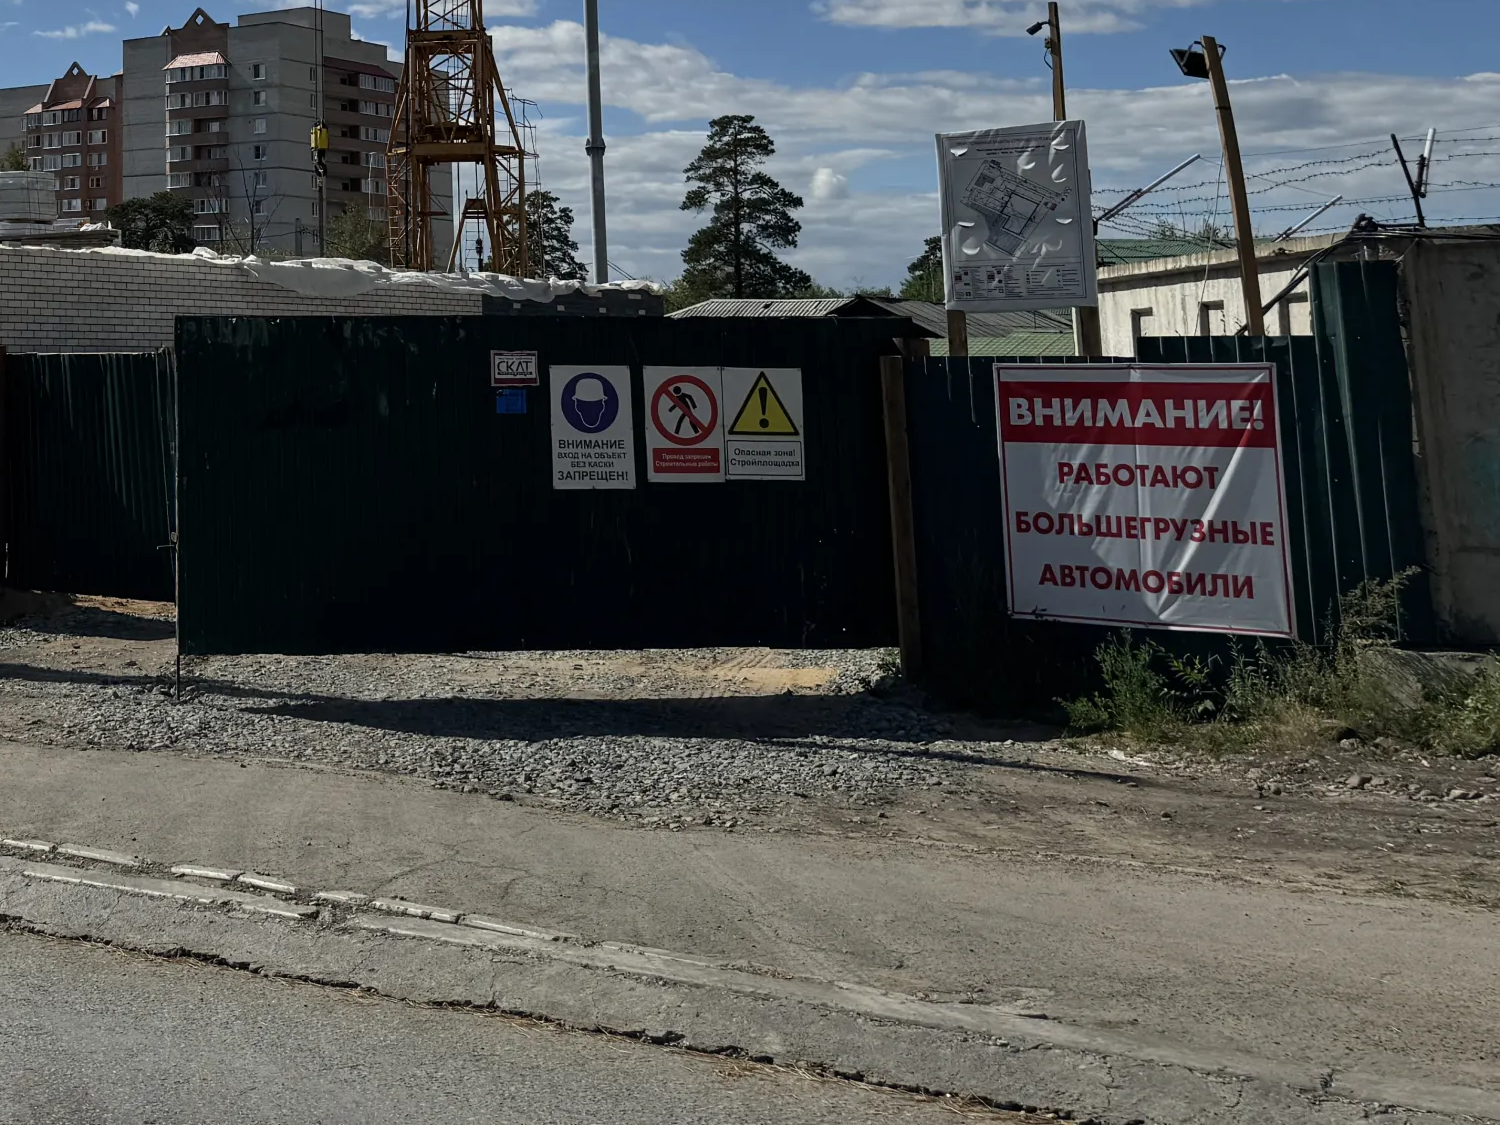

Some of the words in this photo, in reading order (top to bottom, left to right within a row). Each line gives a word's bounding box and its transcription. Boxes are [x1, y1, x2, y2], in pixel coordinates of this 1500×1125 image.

[497, 360, 532, 372] СКАТ
[1008, 397, 1265, 431] ВНИМАНИЕ!
[558, 439, 625, 449] ВНИМАНИЕ
[734, 448, 771, 456] Опасная
[773, 449, 796, 457] зона!
[730, 458, 800, 467] Стройплощадка
[557, 470, 628, 482] ЗАПРЕЩЕН!
[1057, 462, 1219, 490] РАБОТАЮТ
[1015, 511, 1275, 546] БОЛЬШЕГРУЗНЫЕ
[1038, 563, 1254, 599] АВТОМОБИЛИ
